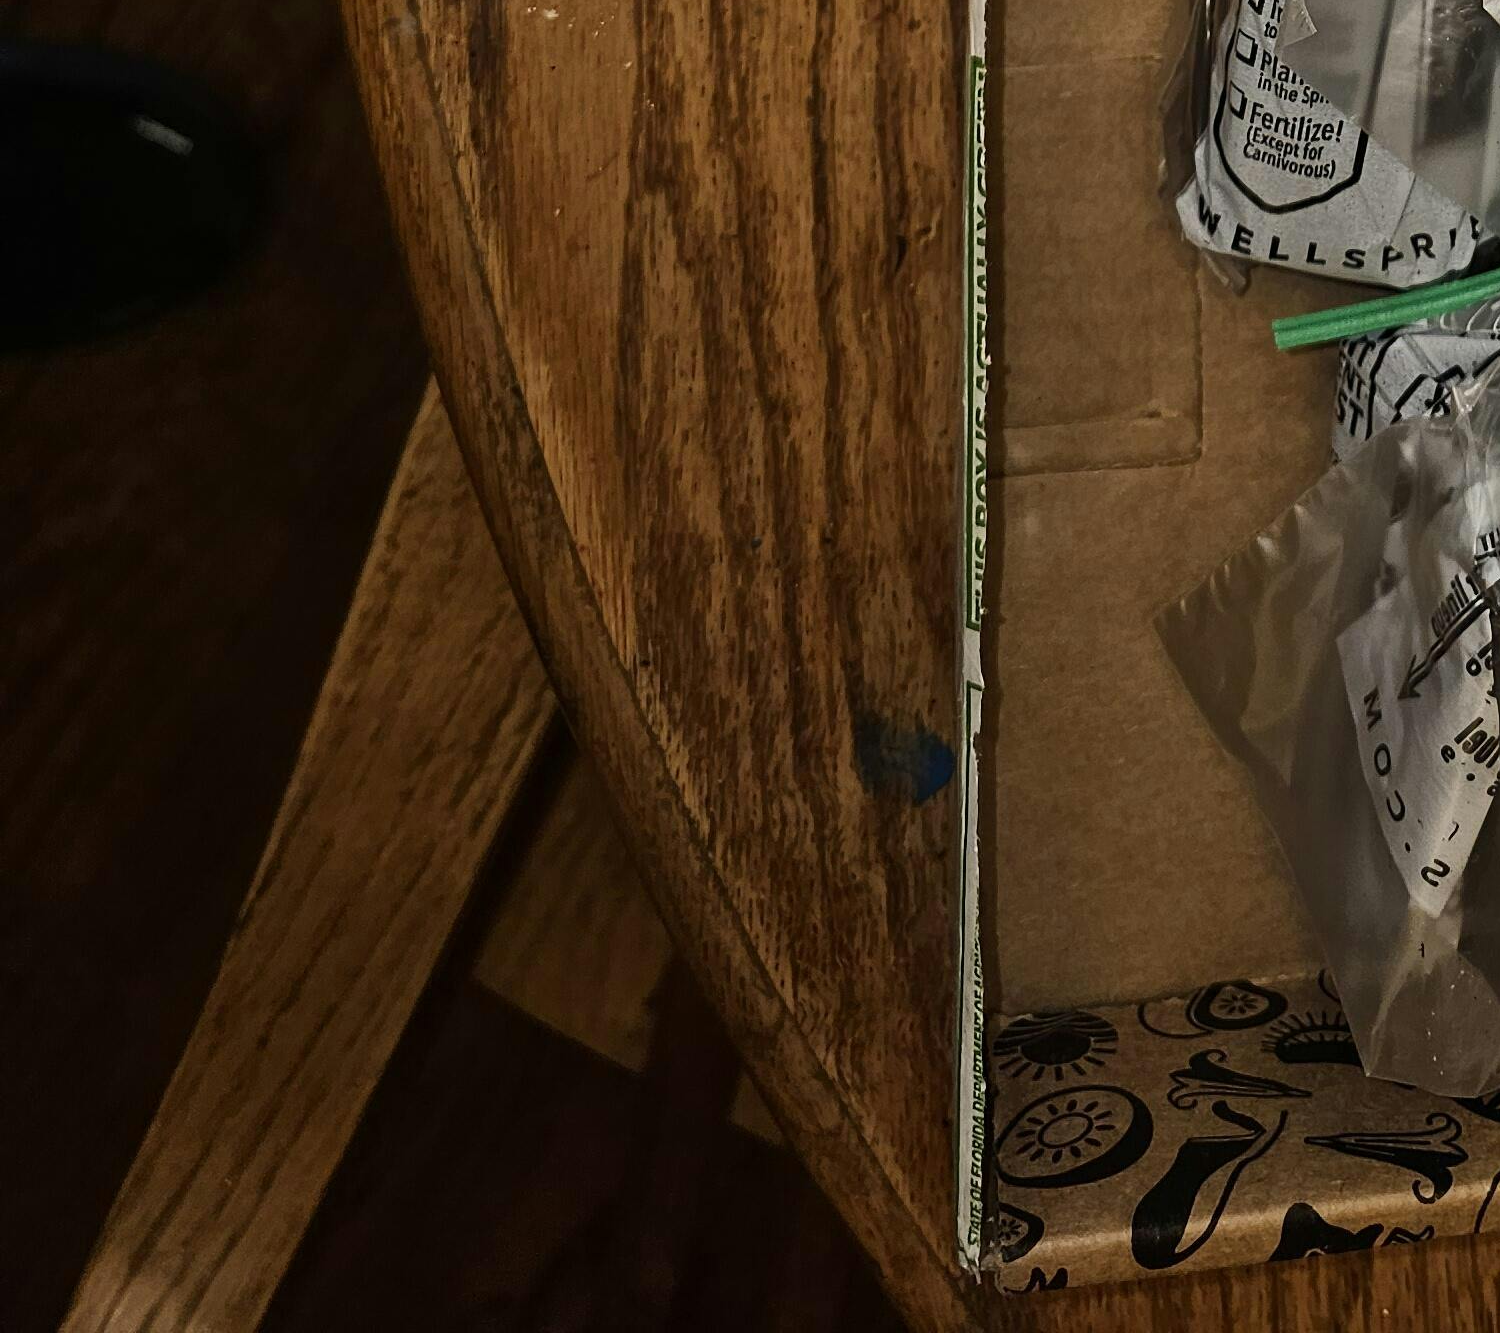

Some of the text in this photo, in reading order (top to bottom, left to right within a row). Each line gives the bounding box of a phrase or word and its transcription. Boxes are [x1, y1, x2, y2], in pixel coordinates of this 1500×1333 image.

[1257, 72, 1272, 92] in
[1274, 83, 1299, 103] the
[1249, 101, 1345, 143] Fertilize!
[1242, 140, 1337, 180] Carnivorous)
[1246, 125, 1325, 162] (Except for
